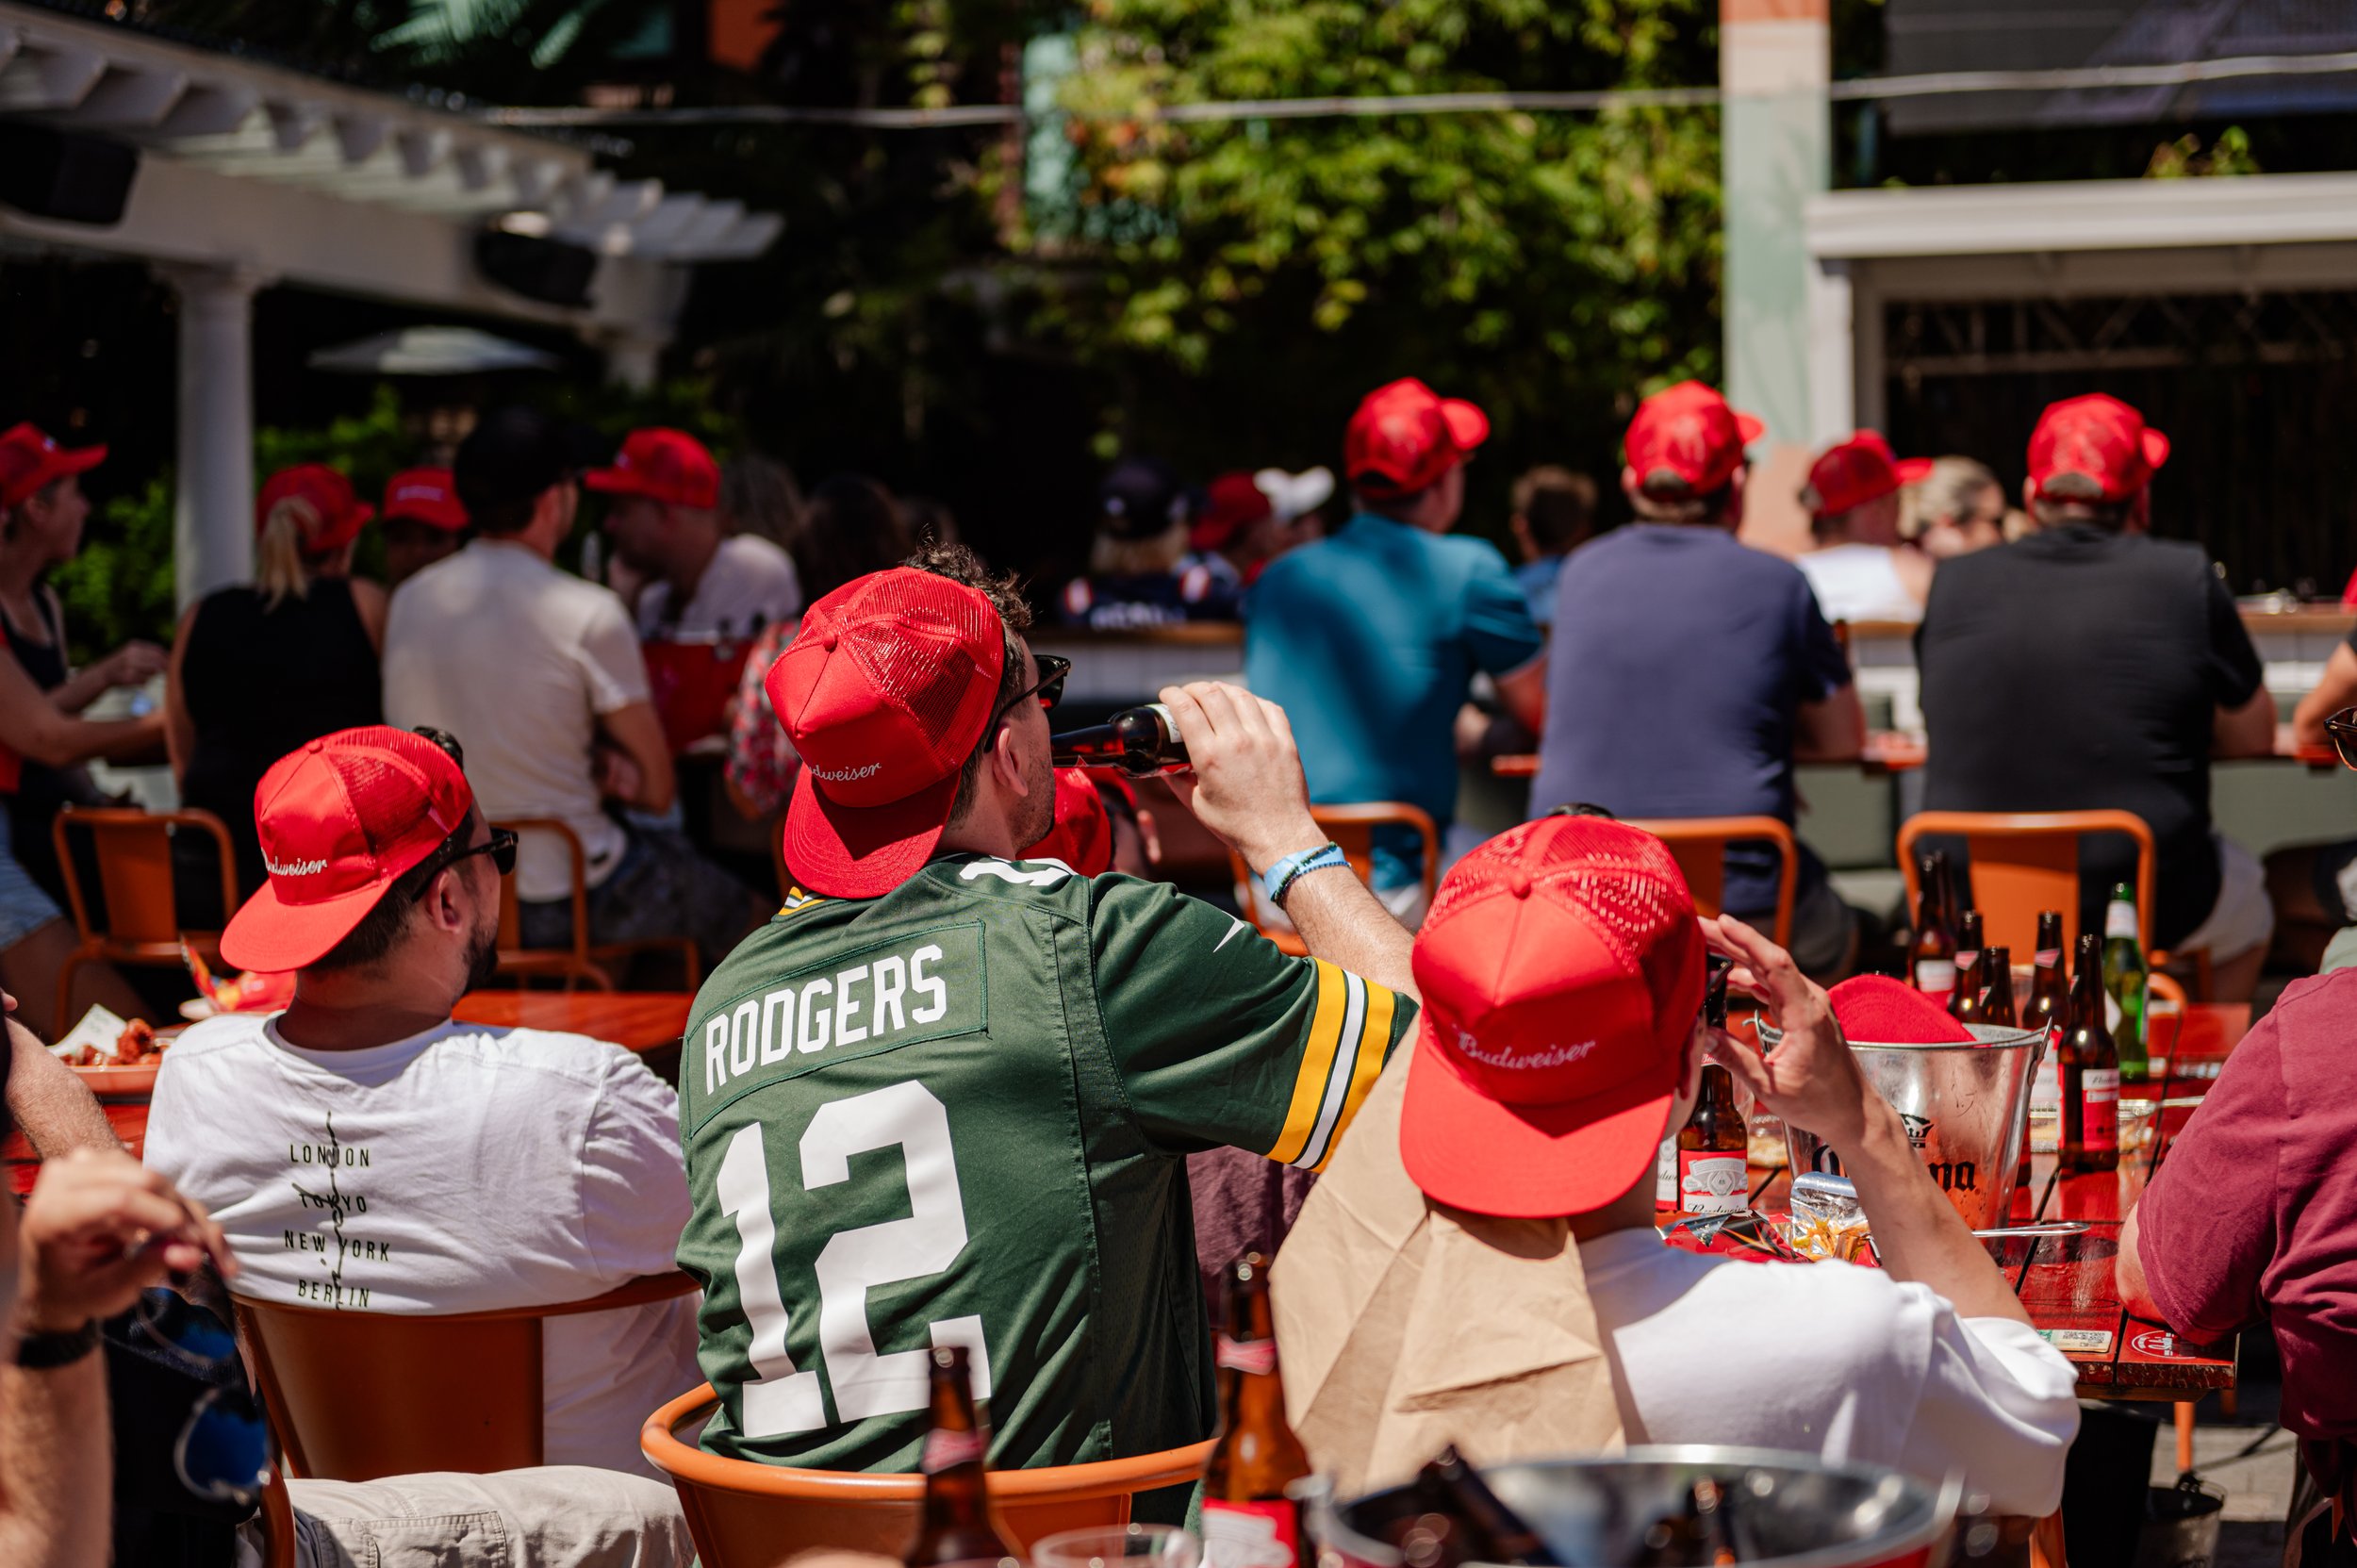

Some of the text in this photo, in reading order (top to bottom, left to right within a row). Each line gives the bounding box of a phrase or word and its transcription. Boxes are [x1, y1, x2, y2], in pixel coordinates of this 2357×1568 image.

[809, 762, 882, 782] dweiser
[706, 944, 947, 1096] RODGERS
[1452, 1023, 1596, 1069] Budweiser
[289, 1144, 370, 1167] LONDON
[299, 1193, 367, 1213] TOKYO
[285, 1230, 390, 1262] NEW YORK
[717, 1080, 991, 1438] 12
[298, 1279, 370, 1308] BERLIN
